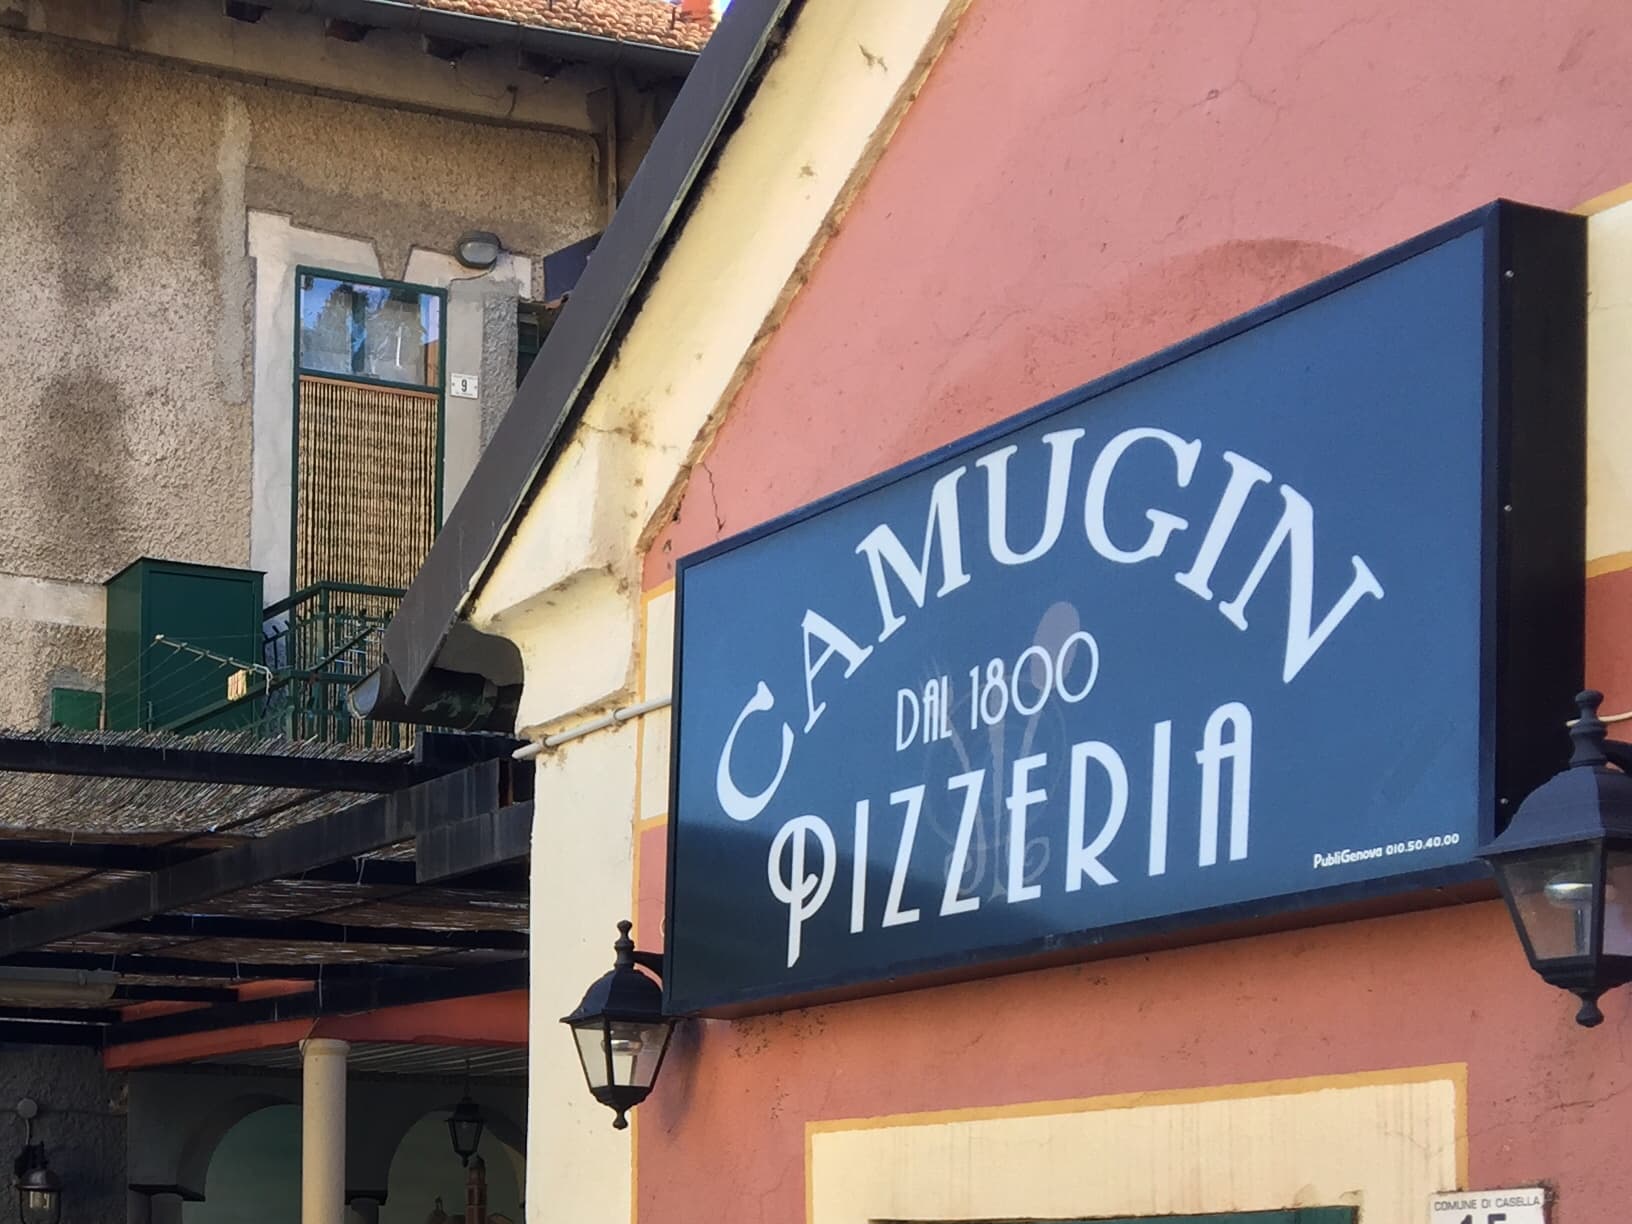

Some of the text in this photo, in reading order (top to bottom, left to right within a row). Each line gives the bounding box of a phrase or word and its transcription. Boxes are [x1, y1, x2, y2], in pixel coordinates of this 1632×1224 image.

[461, 379, 468, 392] 9
[715, 427, 1384, 822] CAMUGIN
[895, 630, 1100, 752] DAL 1800
[768, 700, 1254, 969] PIZZERIA
[1312, 832, 1461, 869] PubliGenova 010.50.40.00
[1433, 1196, 1541, 1212] COMUNE DI CASELLA
